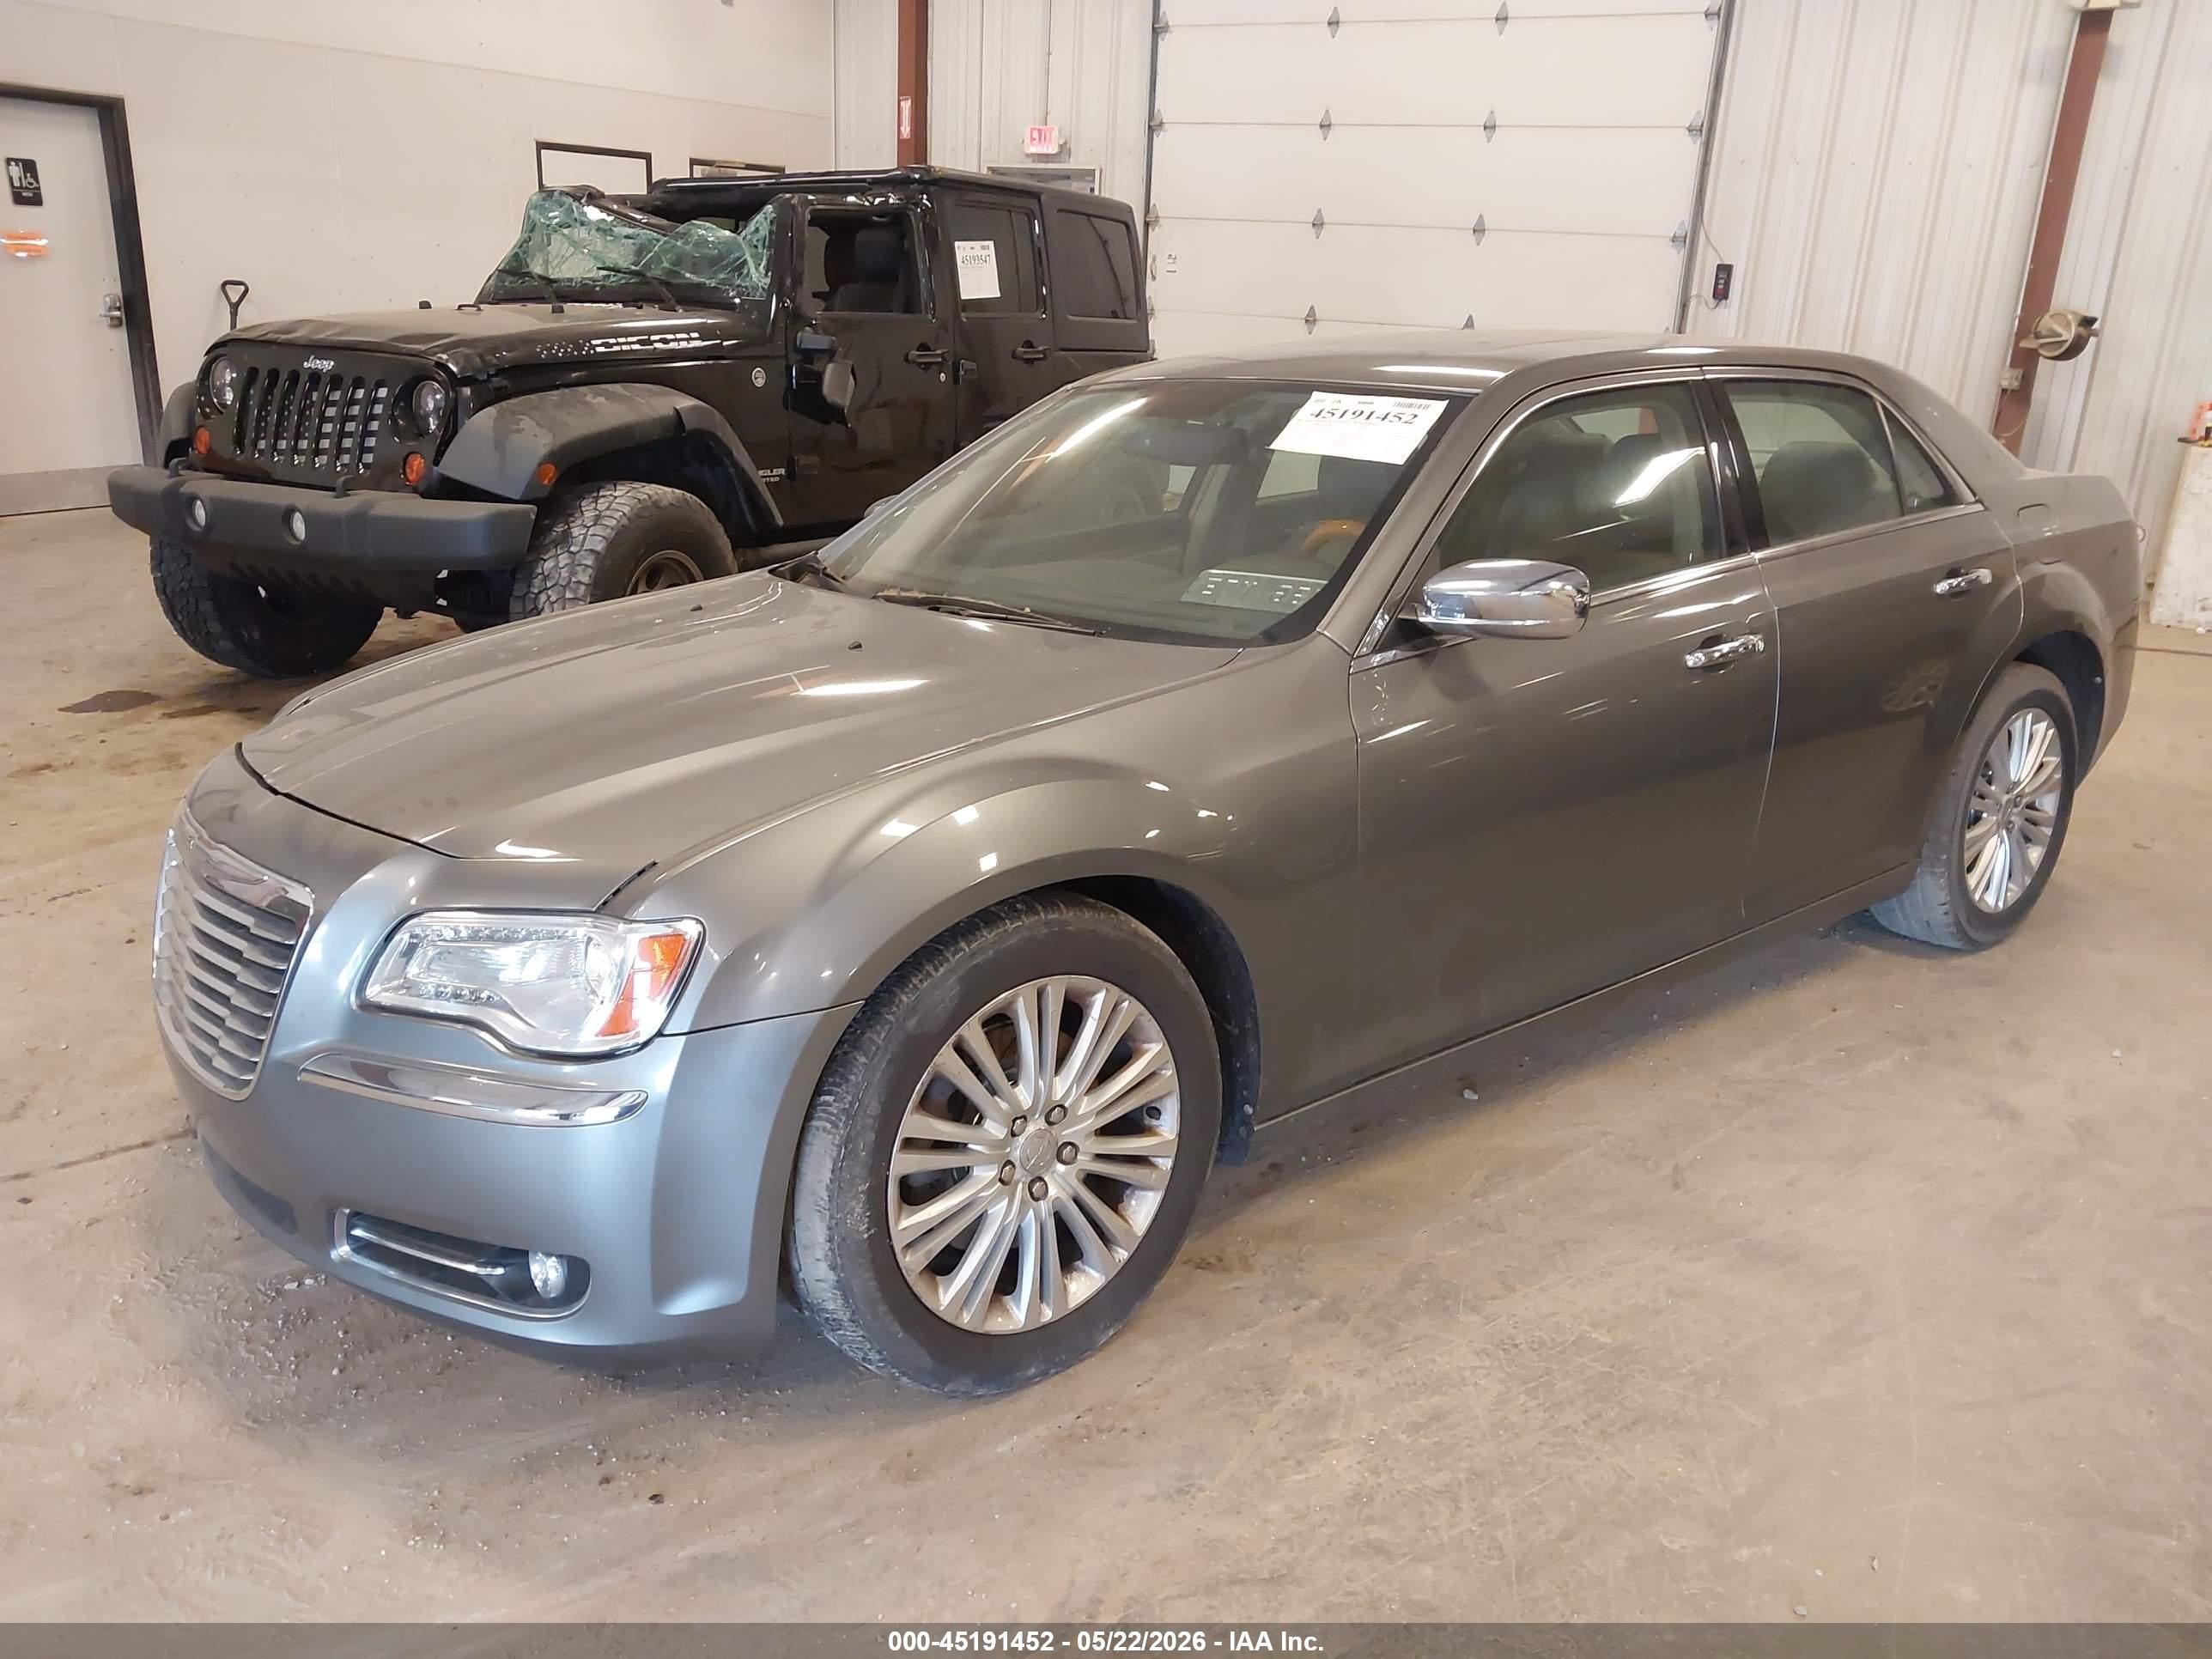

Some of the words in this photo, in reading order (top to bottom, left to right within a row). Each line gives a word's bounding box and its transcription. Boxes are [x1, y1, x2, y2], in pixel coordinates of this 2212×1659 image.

[961, 254, 991, 265] 45193547
[303, 355, 335, 373] Jeep
[1310, 408, 1419, 424] 45191452
